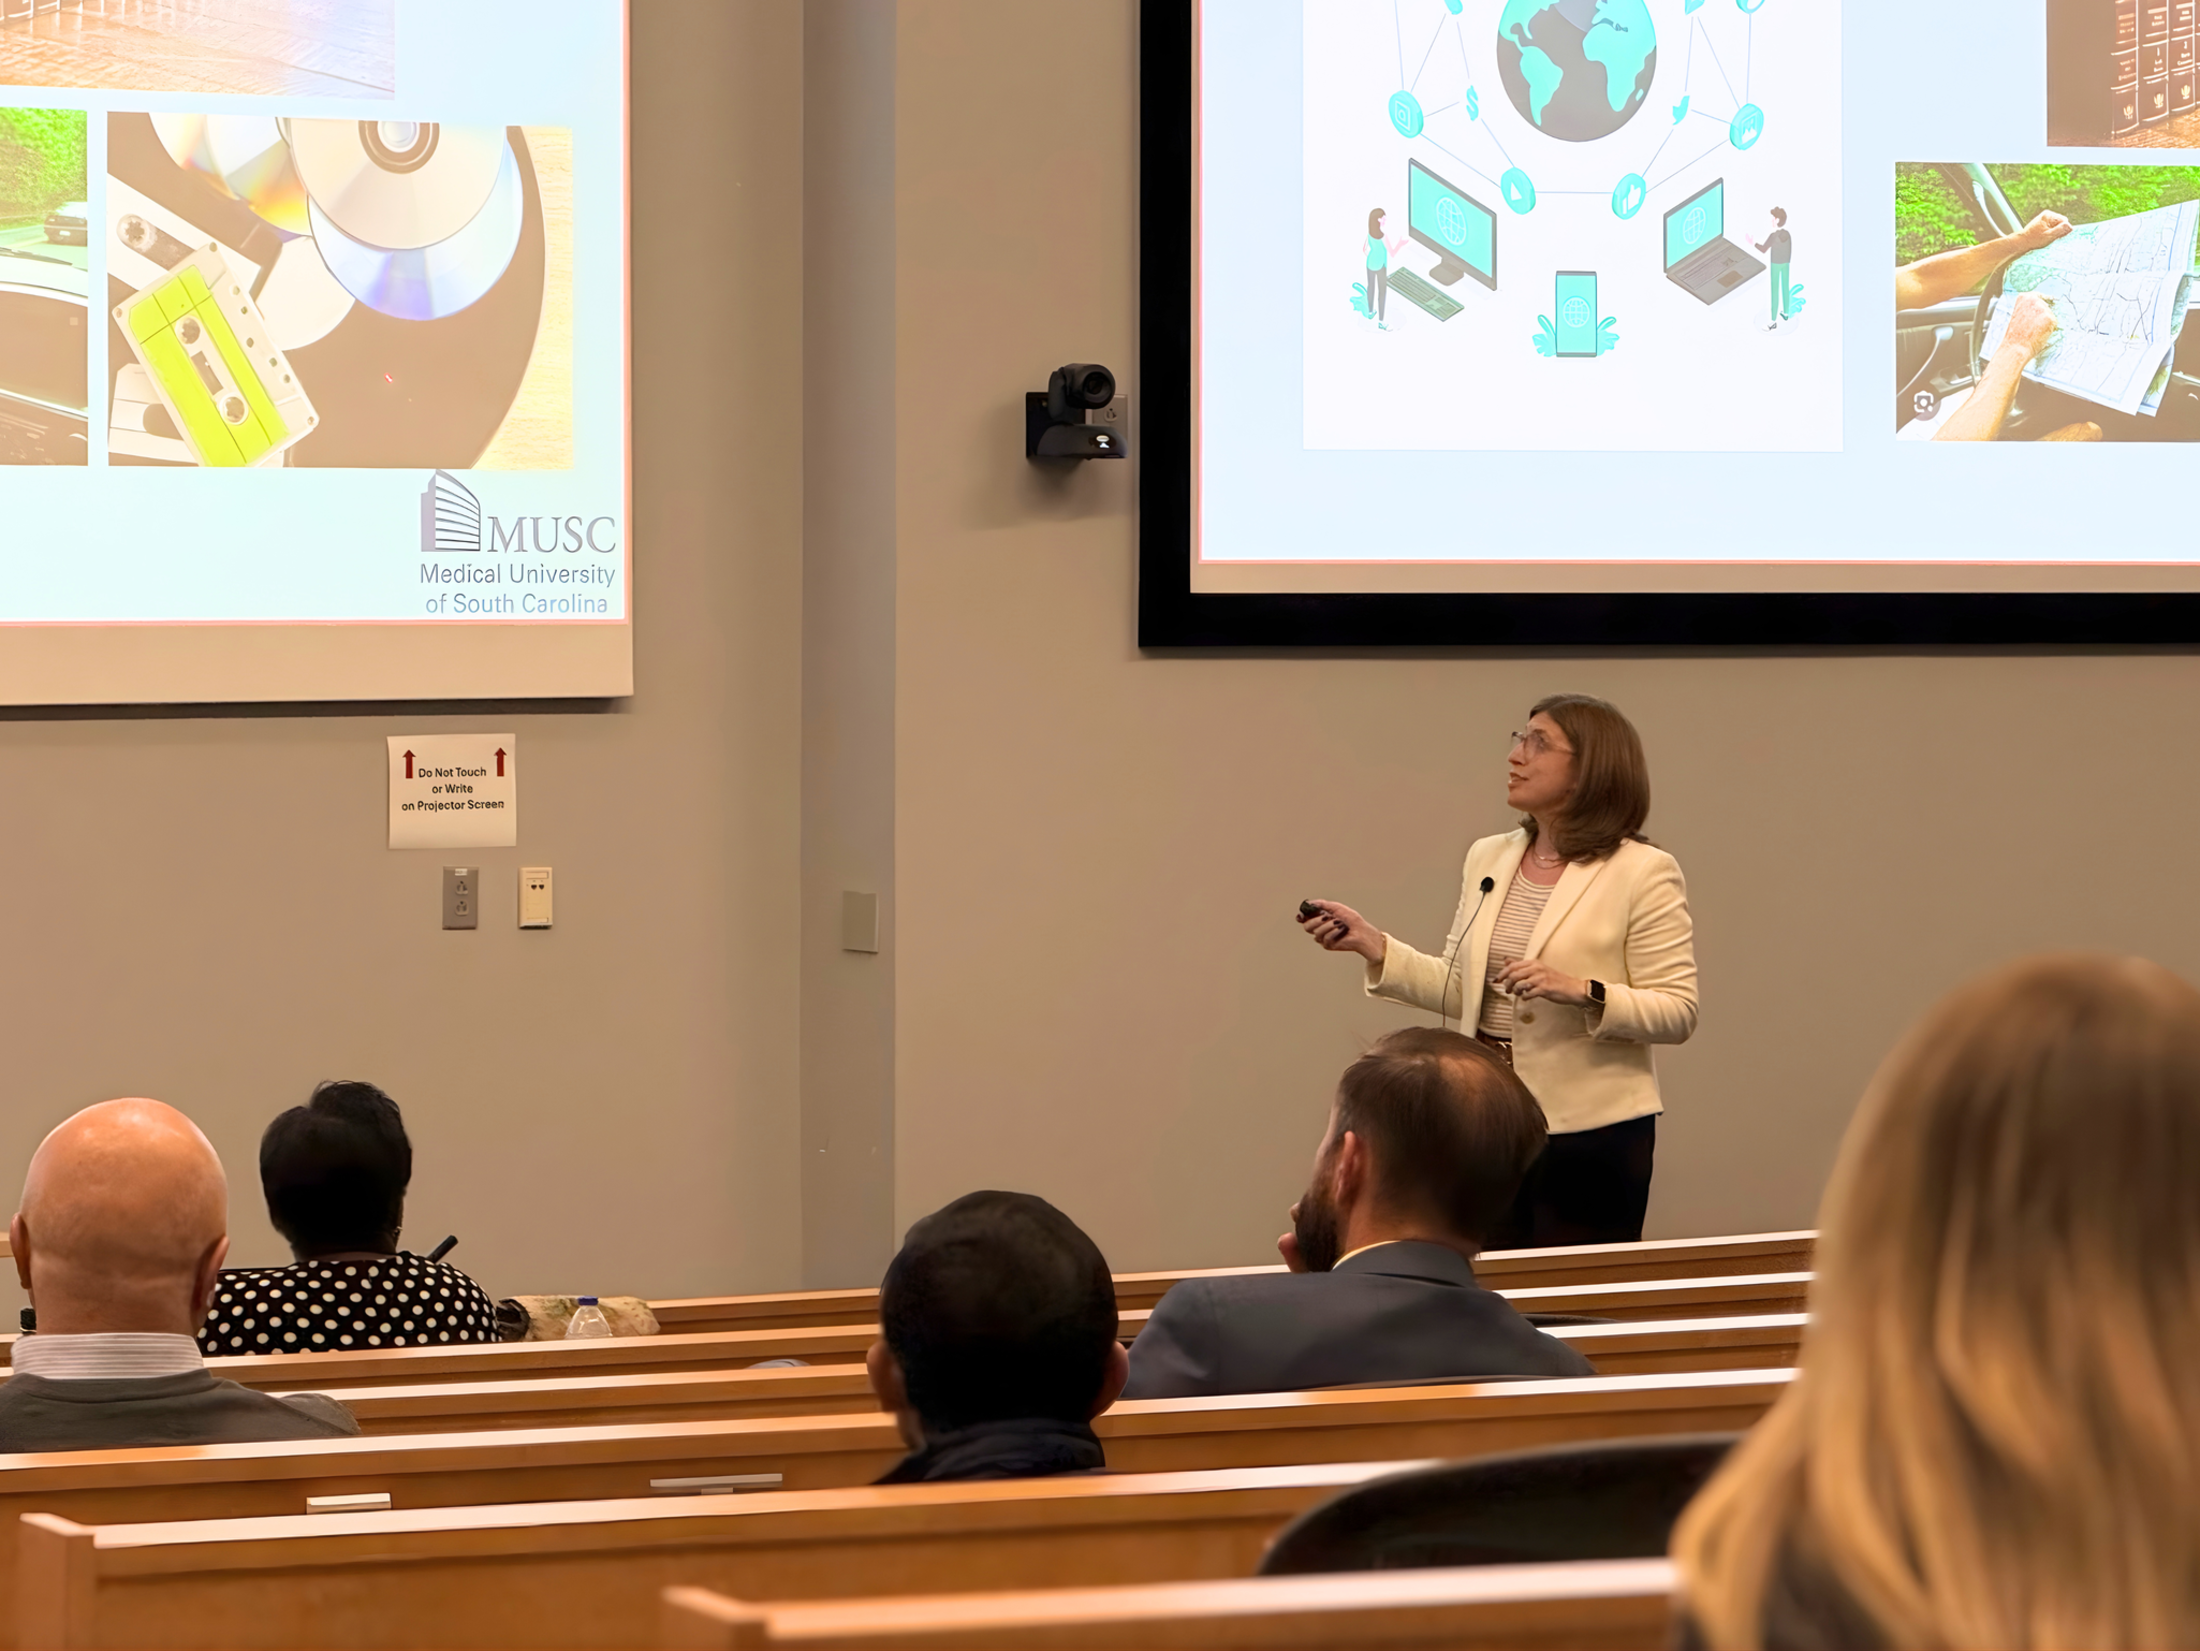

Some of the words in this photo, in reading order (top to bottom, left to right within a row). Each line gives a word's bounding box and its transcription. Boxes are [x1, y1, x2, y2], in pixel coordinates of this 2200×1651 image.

[487, 516, 616, 553] MUSC
[420, 563, 501, 584] Medical
[510, 563, 616, 588] University
[426, 593, 447, 613] of
[453, 593, 515, 613] South
[522, 593, 608, 614] Carolina
[418, 768, 433, 778] Do
[435, 767, 453, 778] Not
[455, 766, 487, 777] Touch
[432, 785, 442, 794] or
[445, 784, 473, 794] Write
[401, 803, 415, 811] on
[417, 800, 466, 812] Projector
[467, 800, 505, 810] Screen
